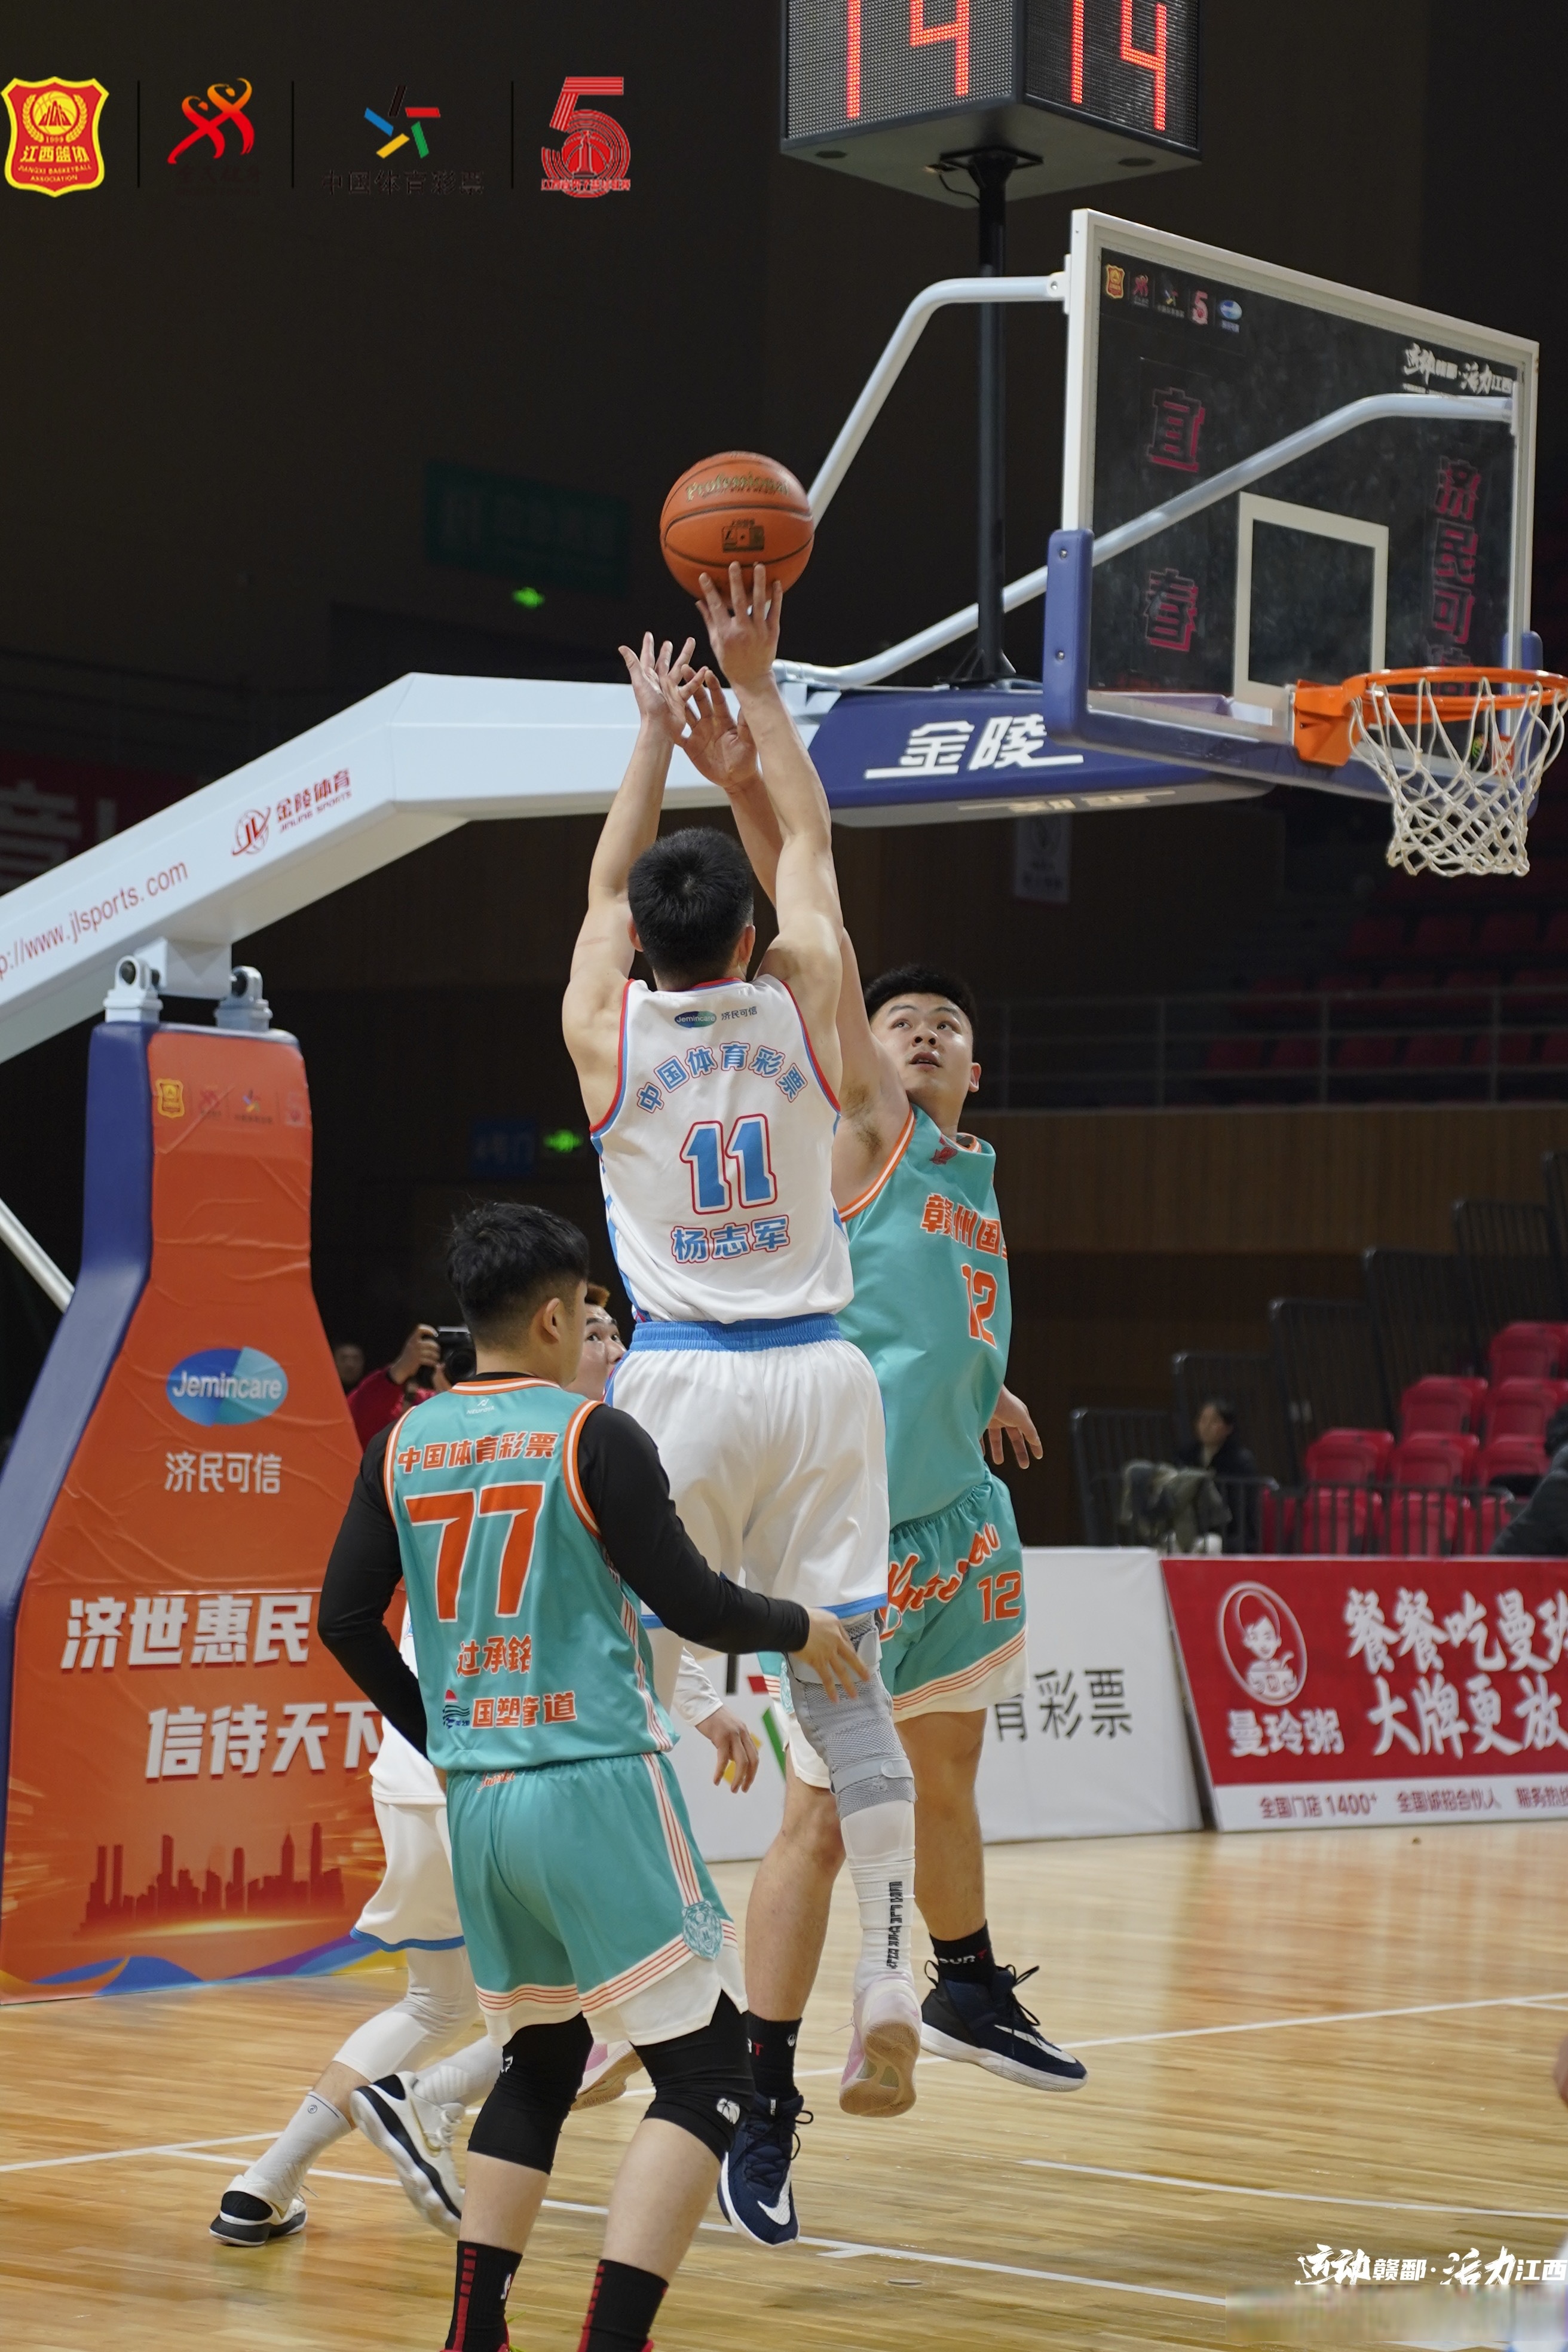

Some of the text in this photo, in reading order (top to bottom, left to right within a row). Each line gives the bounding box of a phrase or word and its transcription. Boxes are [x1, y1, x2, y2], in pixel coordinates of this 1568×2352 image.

[865, 713, 1085, 779] 金陵
[277, 767, 350, 822] 金陵体育
[721, 1006, 758, 1021] 济民可信
[637, 1041, 808, 1114] 中国体育彩票
[680, 1113, 777, 1215] 11
[670, 1214, 791, 1264] 杨志军
[920, 1192, 1007, 1260] 赣州国
[960, 1262, 997, 1350] 12
[172, 1370, 283, 1400] Jemincare
[164, 1451, 282, 1494] 济民可信
[397, 1431, 561, 1474] 中国体育彩票
[404, 1481, 545, 1623] 77
[976, 1570, 1022, 1625] 12
[61, 1594, 313, 1670] 济世惠民
[470, 1690, 578, 1729] 国塑管道
[1227, 1707, 1345, 1757] 曼玲粥
[1367, 1673, 1568, 1760] 大牌更放
[145, 1701, 381, 1779] 信待天下
